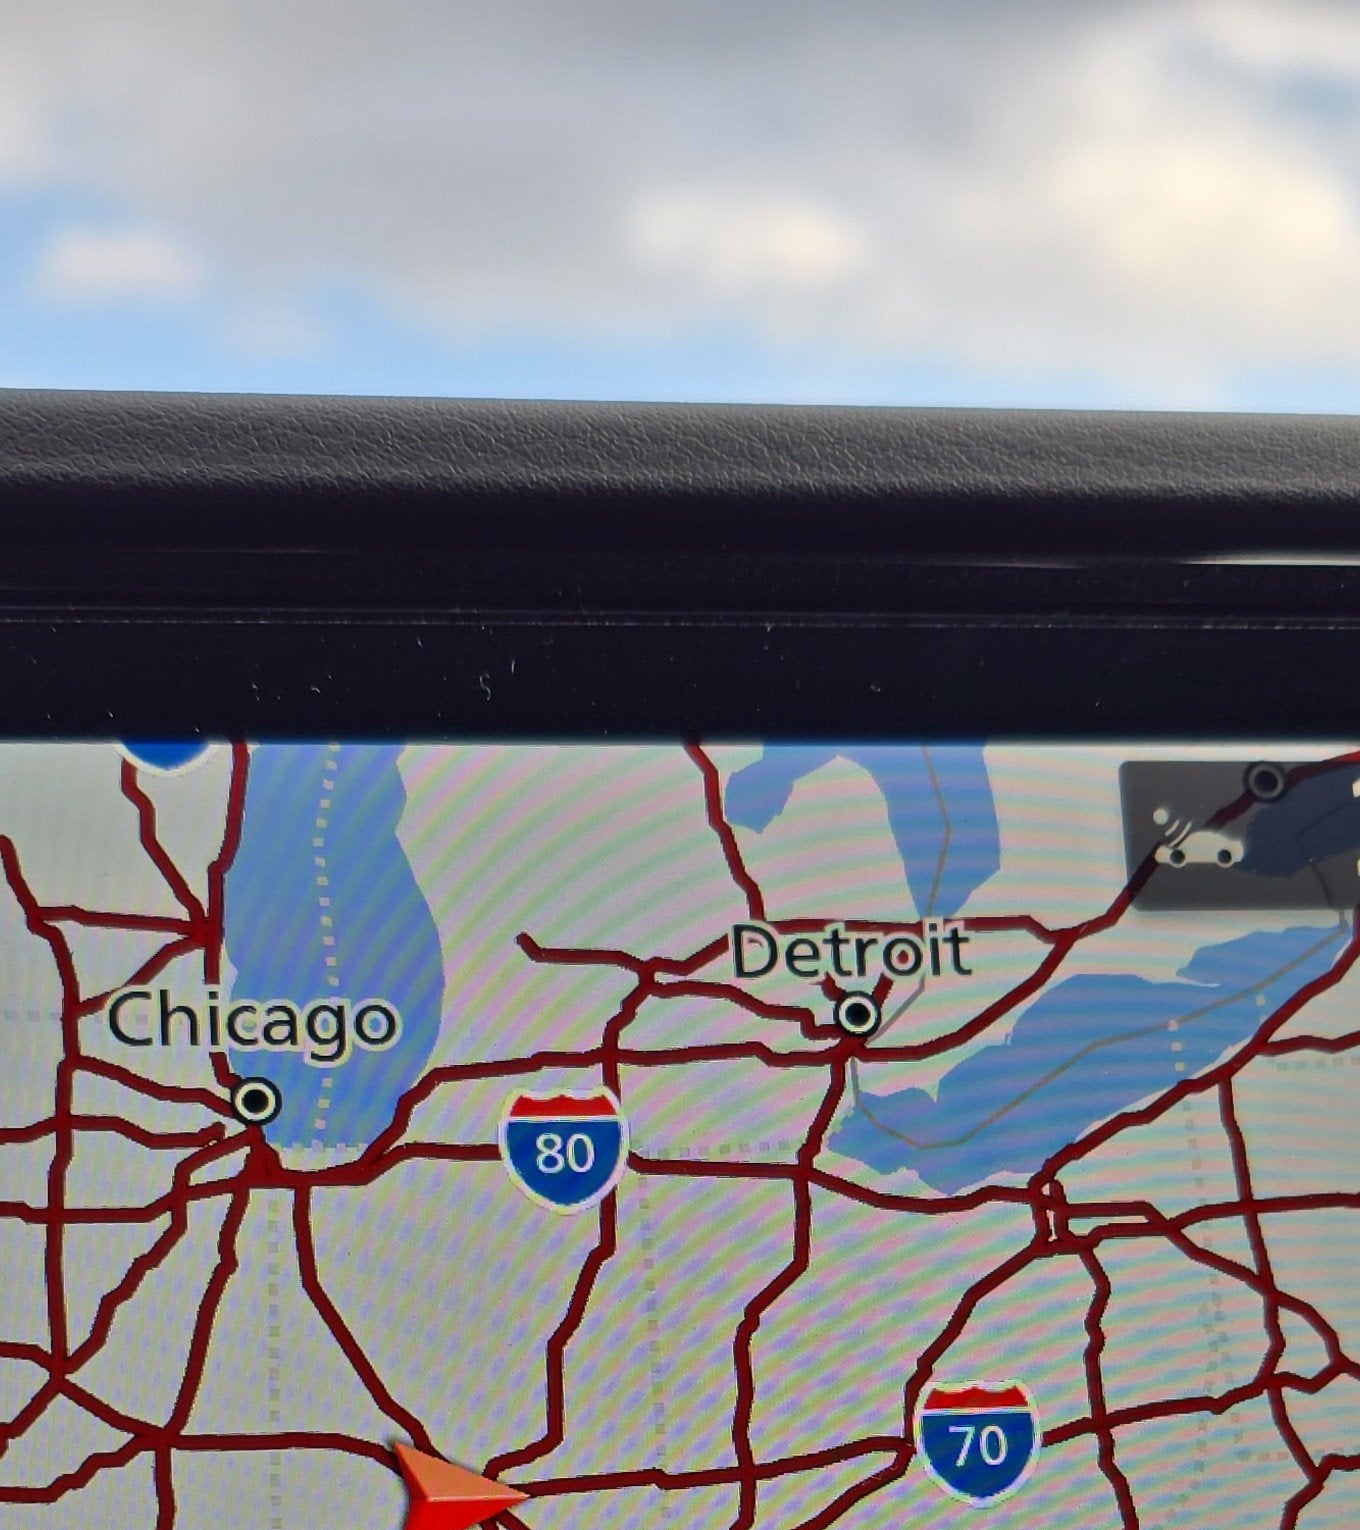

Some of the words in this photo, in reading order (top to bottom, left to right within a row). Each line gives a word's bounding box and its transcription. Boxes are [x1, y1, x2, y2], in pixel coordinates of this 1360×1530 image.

[733, 921, 972, 978] Detroit
[108, 989, 397, 1062] Chicago
[535, 1131, 595, 1174] 80
[948, 1426, 1008, 1467] 70
